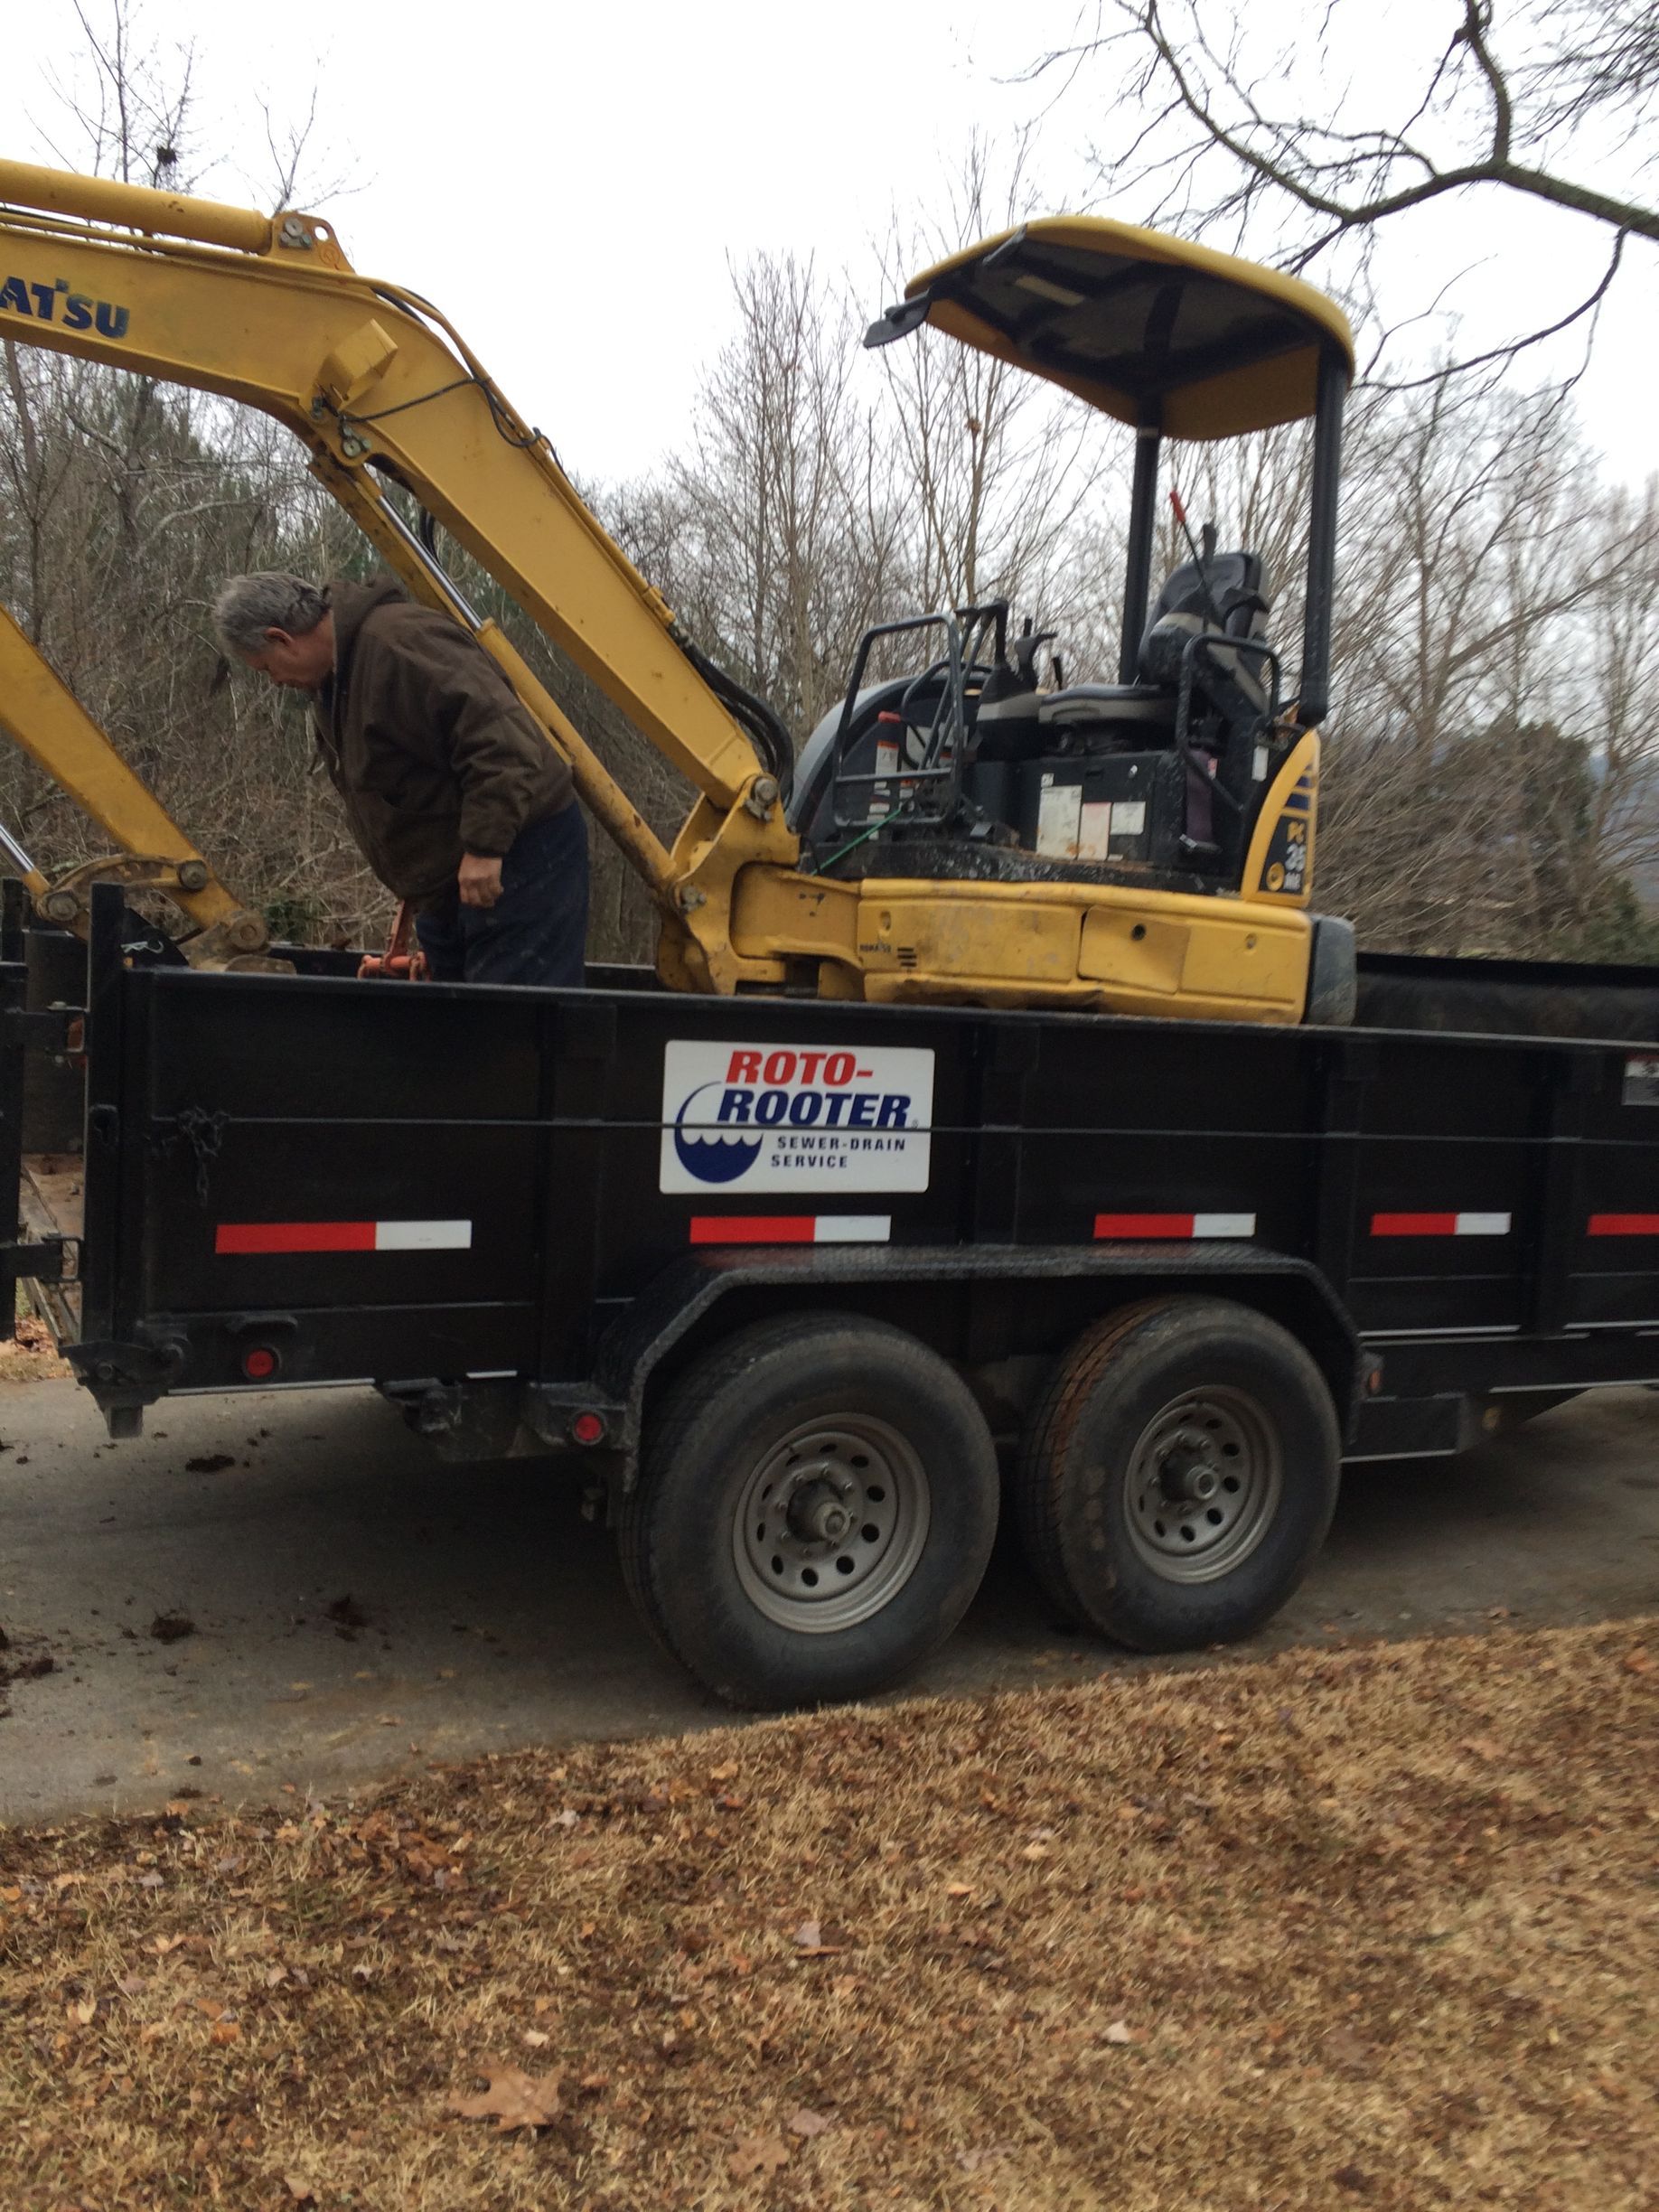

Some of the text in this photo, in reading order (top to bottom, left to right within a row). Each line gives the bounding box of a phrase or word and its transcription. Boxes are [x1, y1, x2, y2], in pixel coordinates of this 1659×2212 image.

[726, 1050, 874, 1087] ROTO-
[717, 1089, 911, 1129] ROOTER
[771, 1154, 848, 1168] SERVICE
